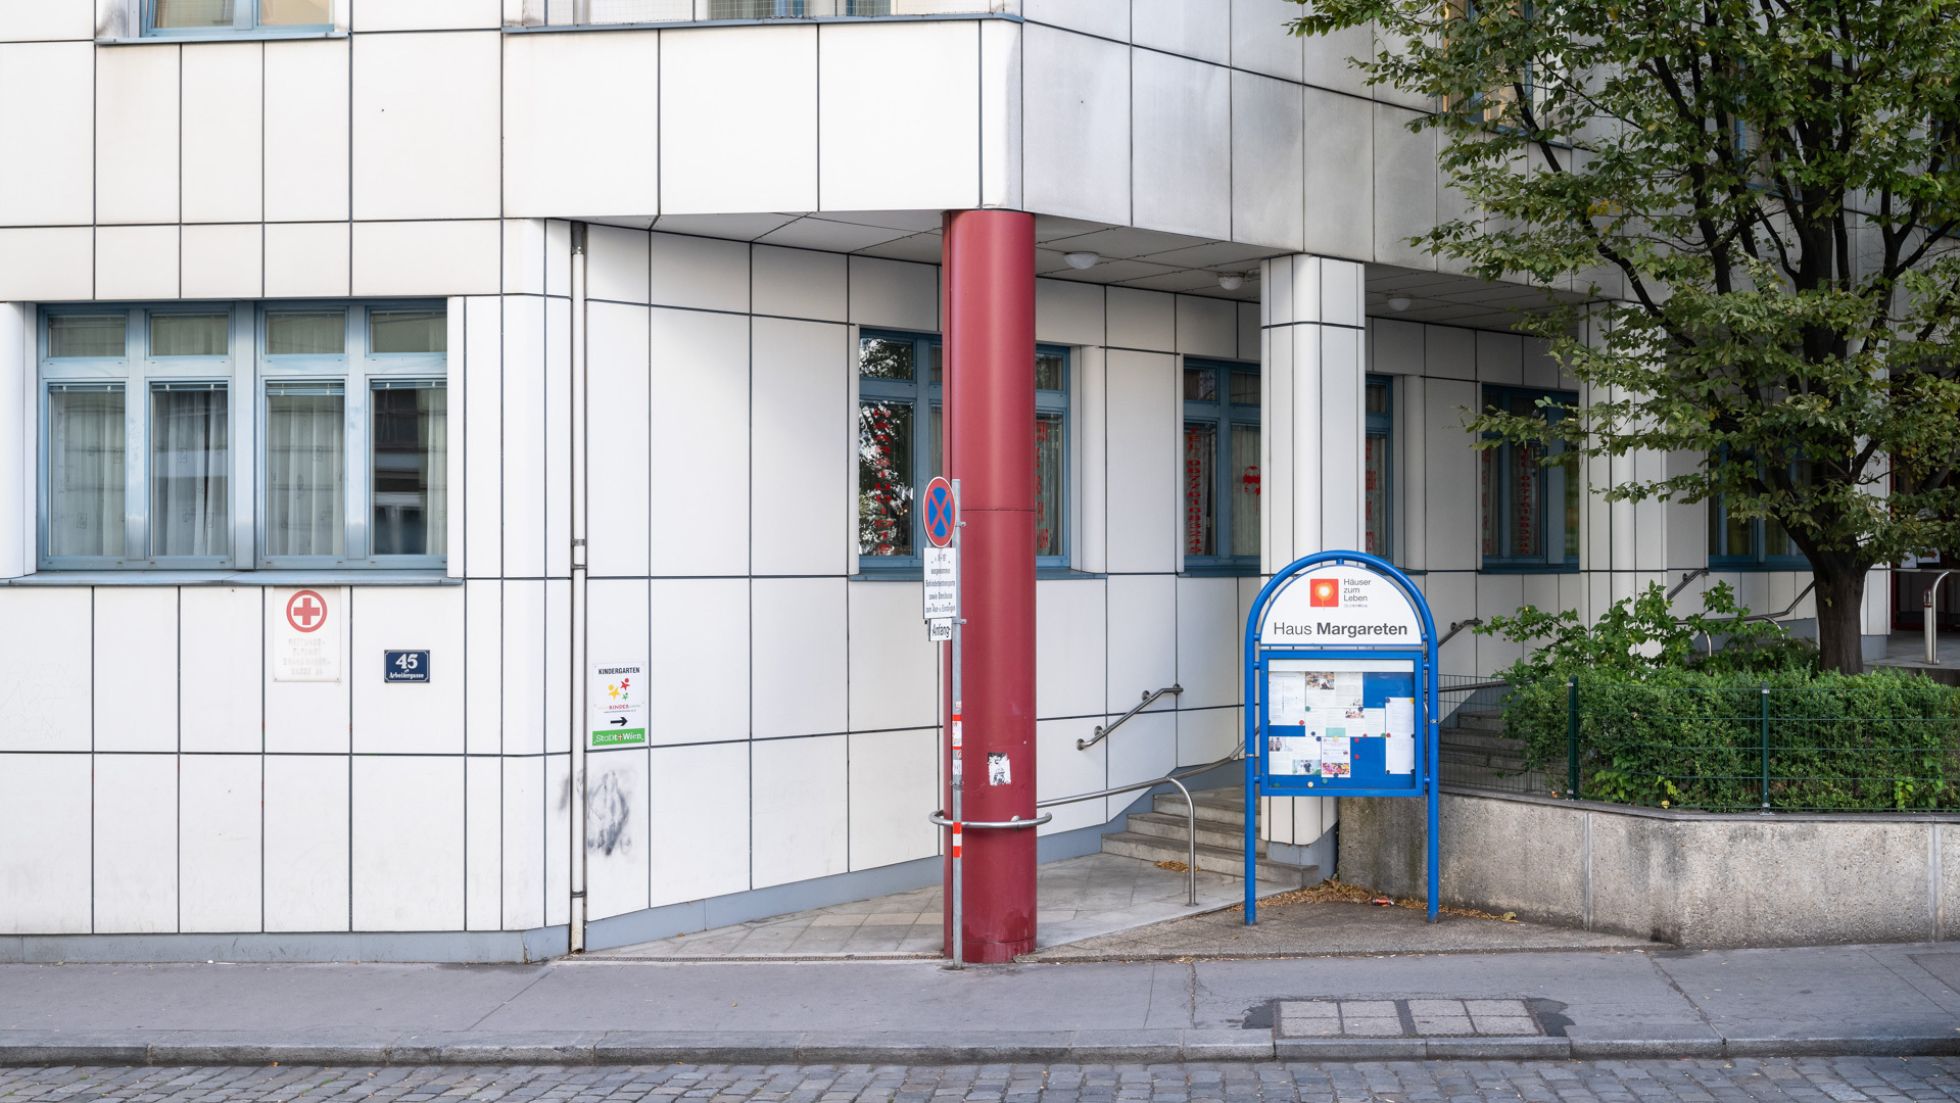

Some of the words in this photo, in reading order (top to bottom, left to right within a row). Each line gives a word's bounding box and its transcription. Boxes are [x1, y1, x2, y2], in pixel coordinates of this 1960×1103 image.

[1343, 578, 1371, 586] Häuser
[1343, 594, 1368, 602] Leben
[932, 624, 951, 638] Anfang
[1274, 622, 1312, 635] Haus
[1317, 622, 1408, 638] Margareten
[395, 653, 418, 669] 45
